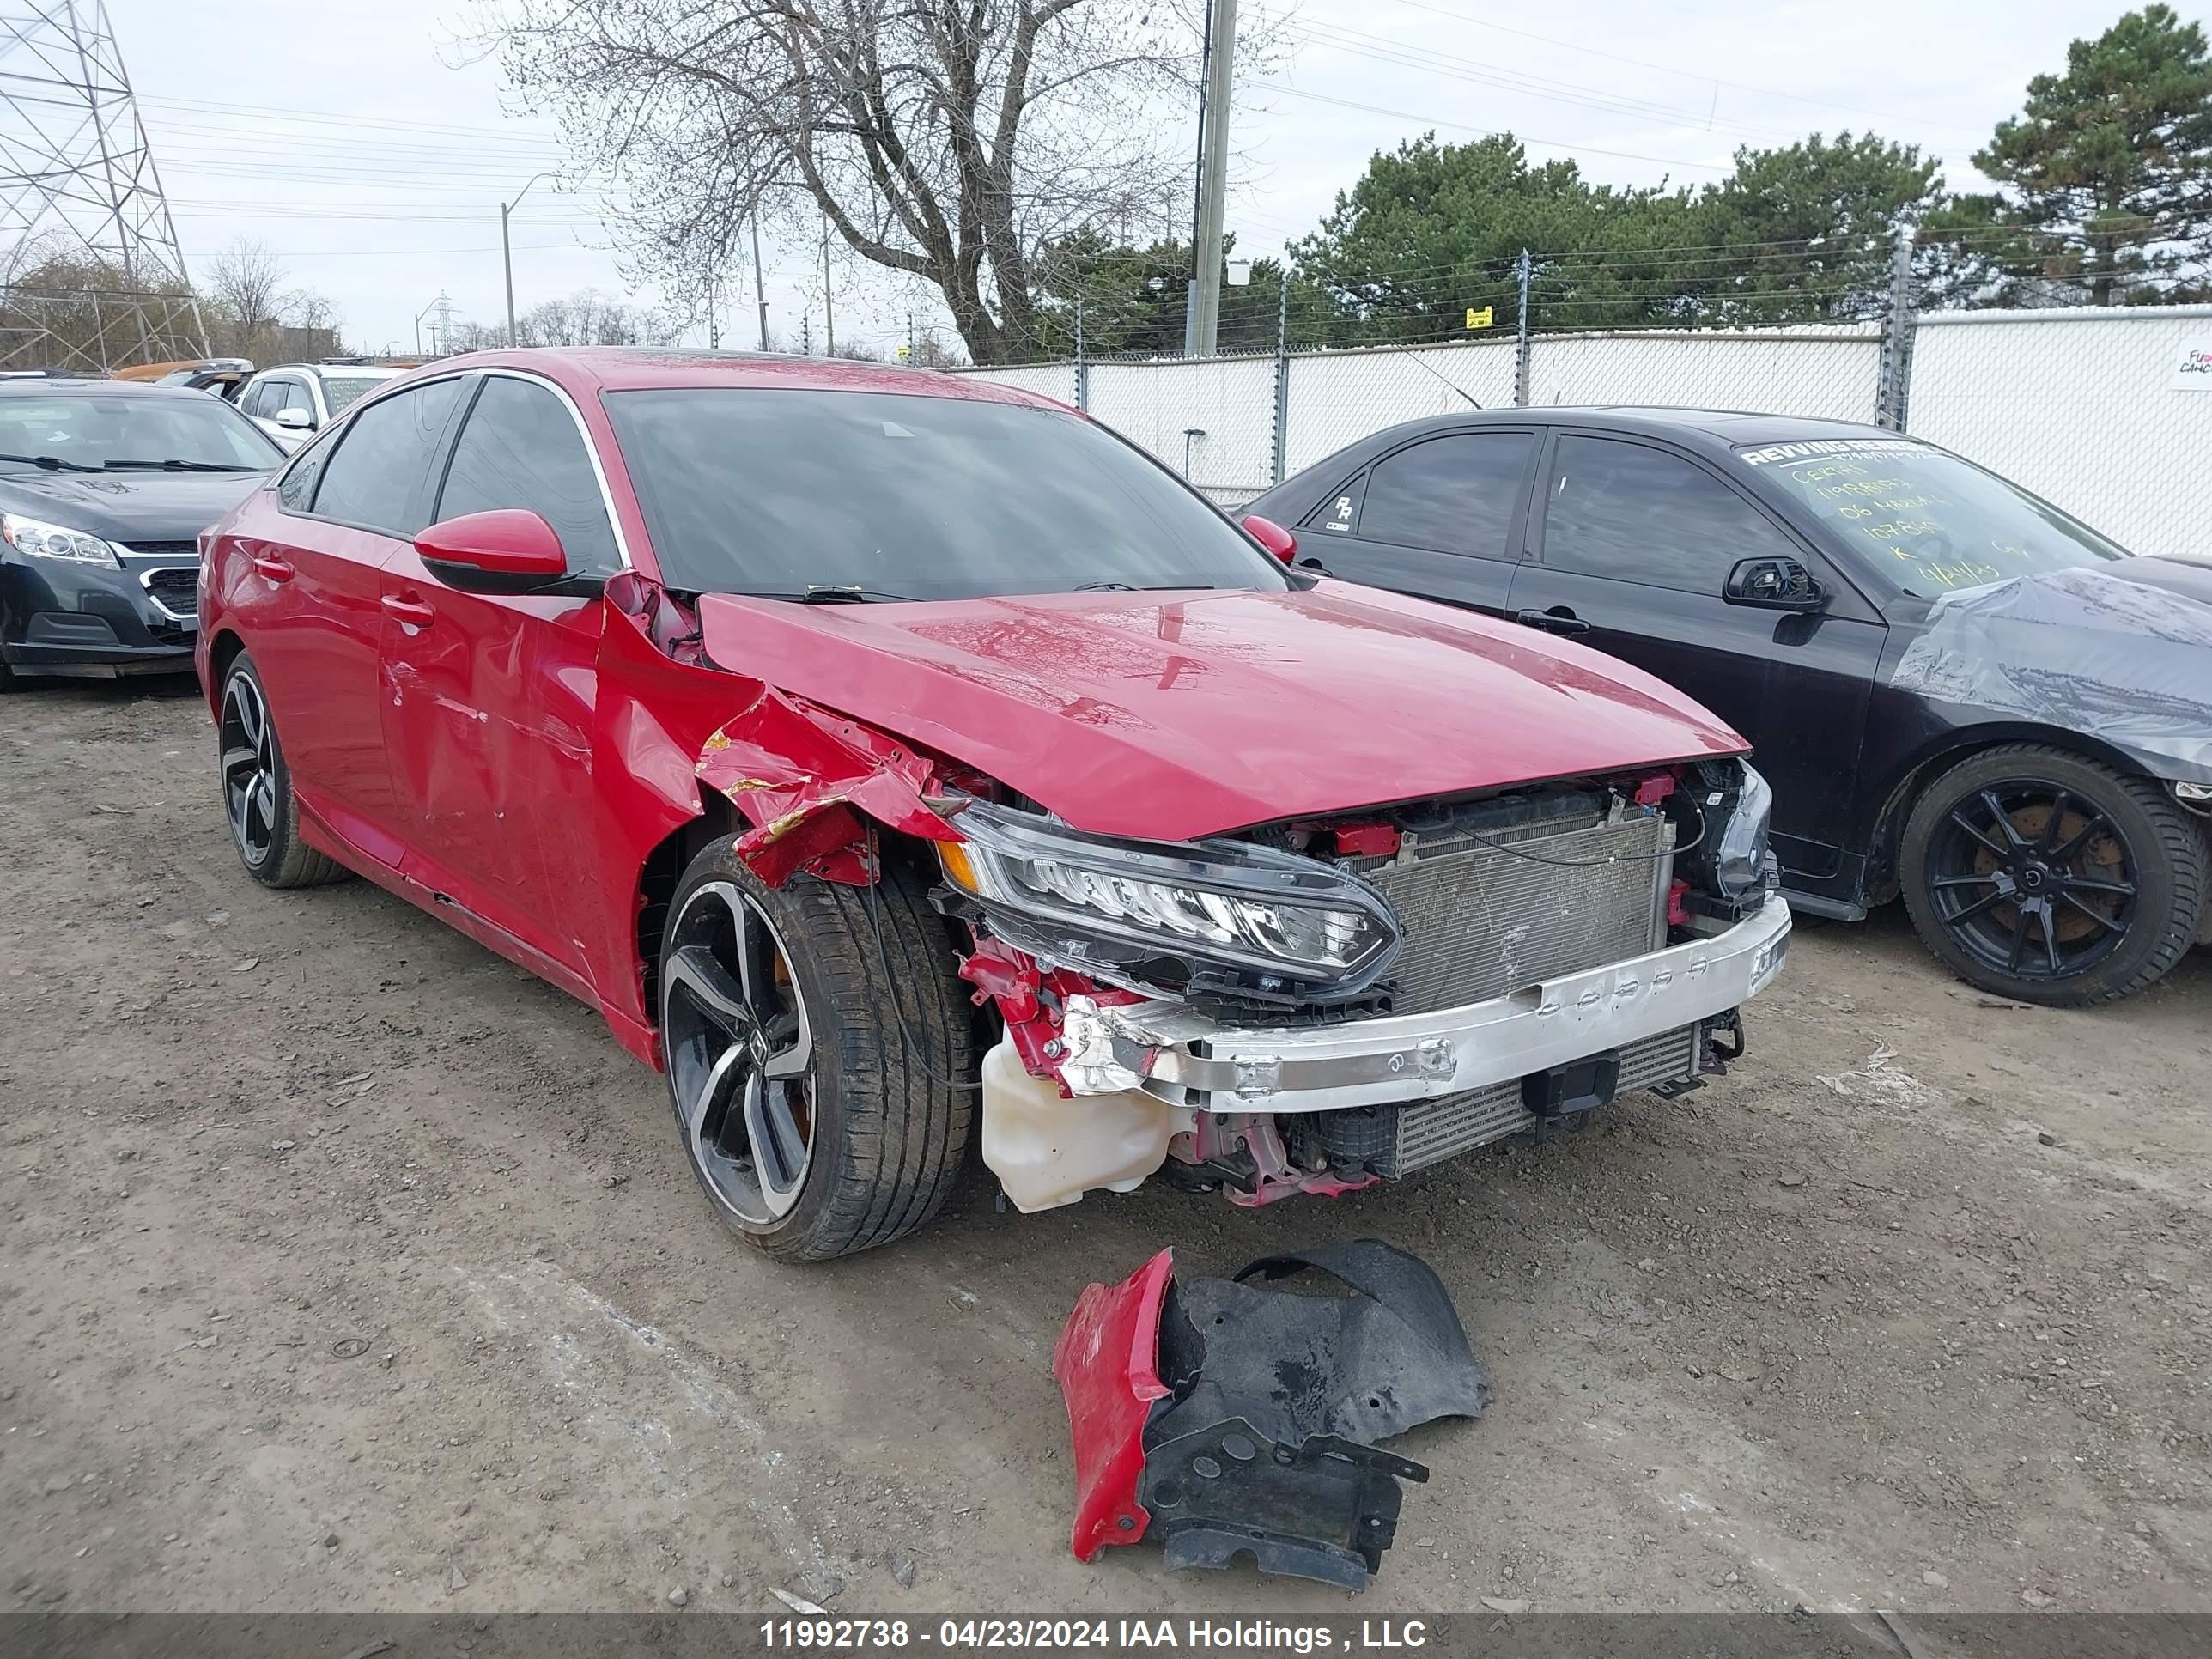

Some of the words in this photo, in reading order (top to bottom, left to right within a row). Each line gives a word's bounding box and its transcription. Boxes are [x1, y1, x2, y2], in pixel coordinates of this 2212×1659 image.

[2179, 362, 2212, 374] CANC
[1740, 441, 1852, 466] REVVING
[1838, 504, 1873, 520] 06
[1889, 546, 1917, 561] K
